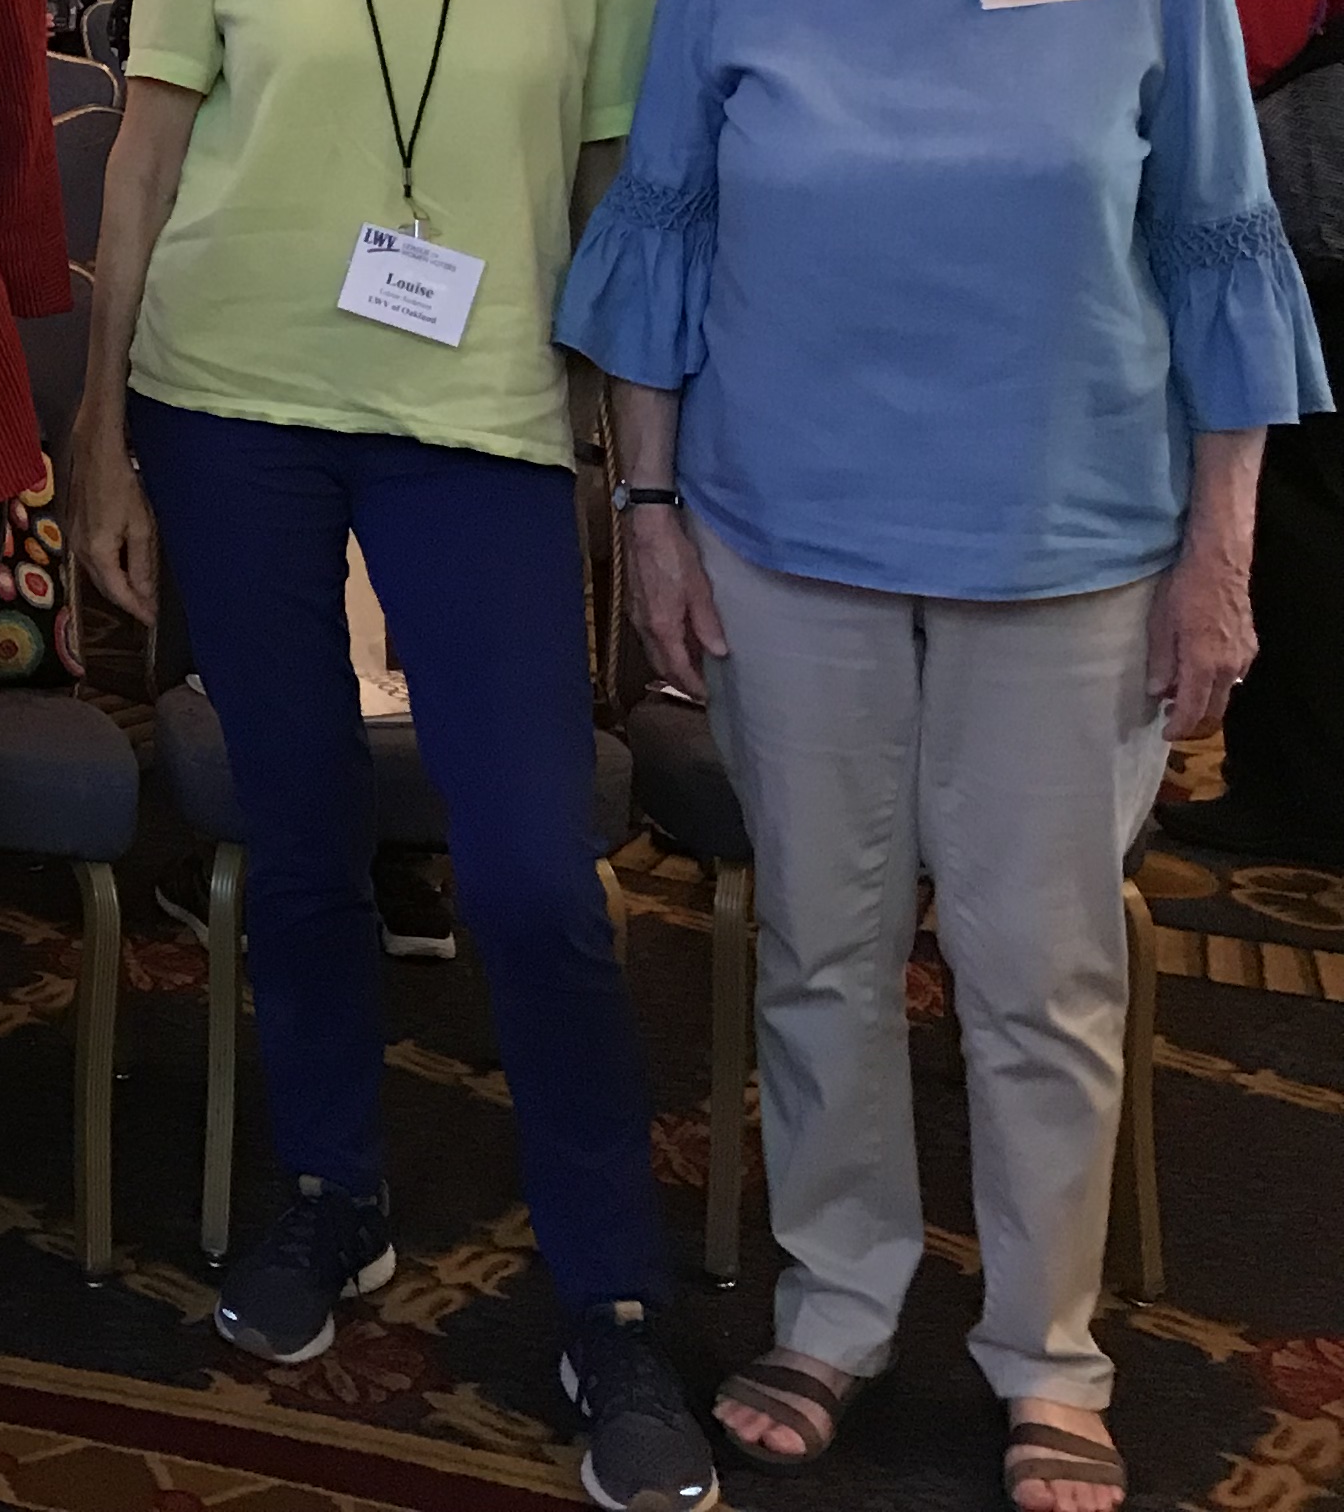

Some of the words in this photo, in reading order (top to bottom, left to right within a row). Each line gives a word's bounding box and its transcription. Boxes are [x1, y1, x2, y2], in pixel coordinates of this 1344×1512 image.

[364, 228, 398, 248] LWV
[386, 273, 434, 298] Louise
[368, 296, 388, 307] LWV
[391, 303, 400, 312] of
[401, 306, 437, 324] Oakland
